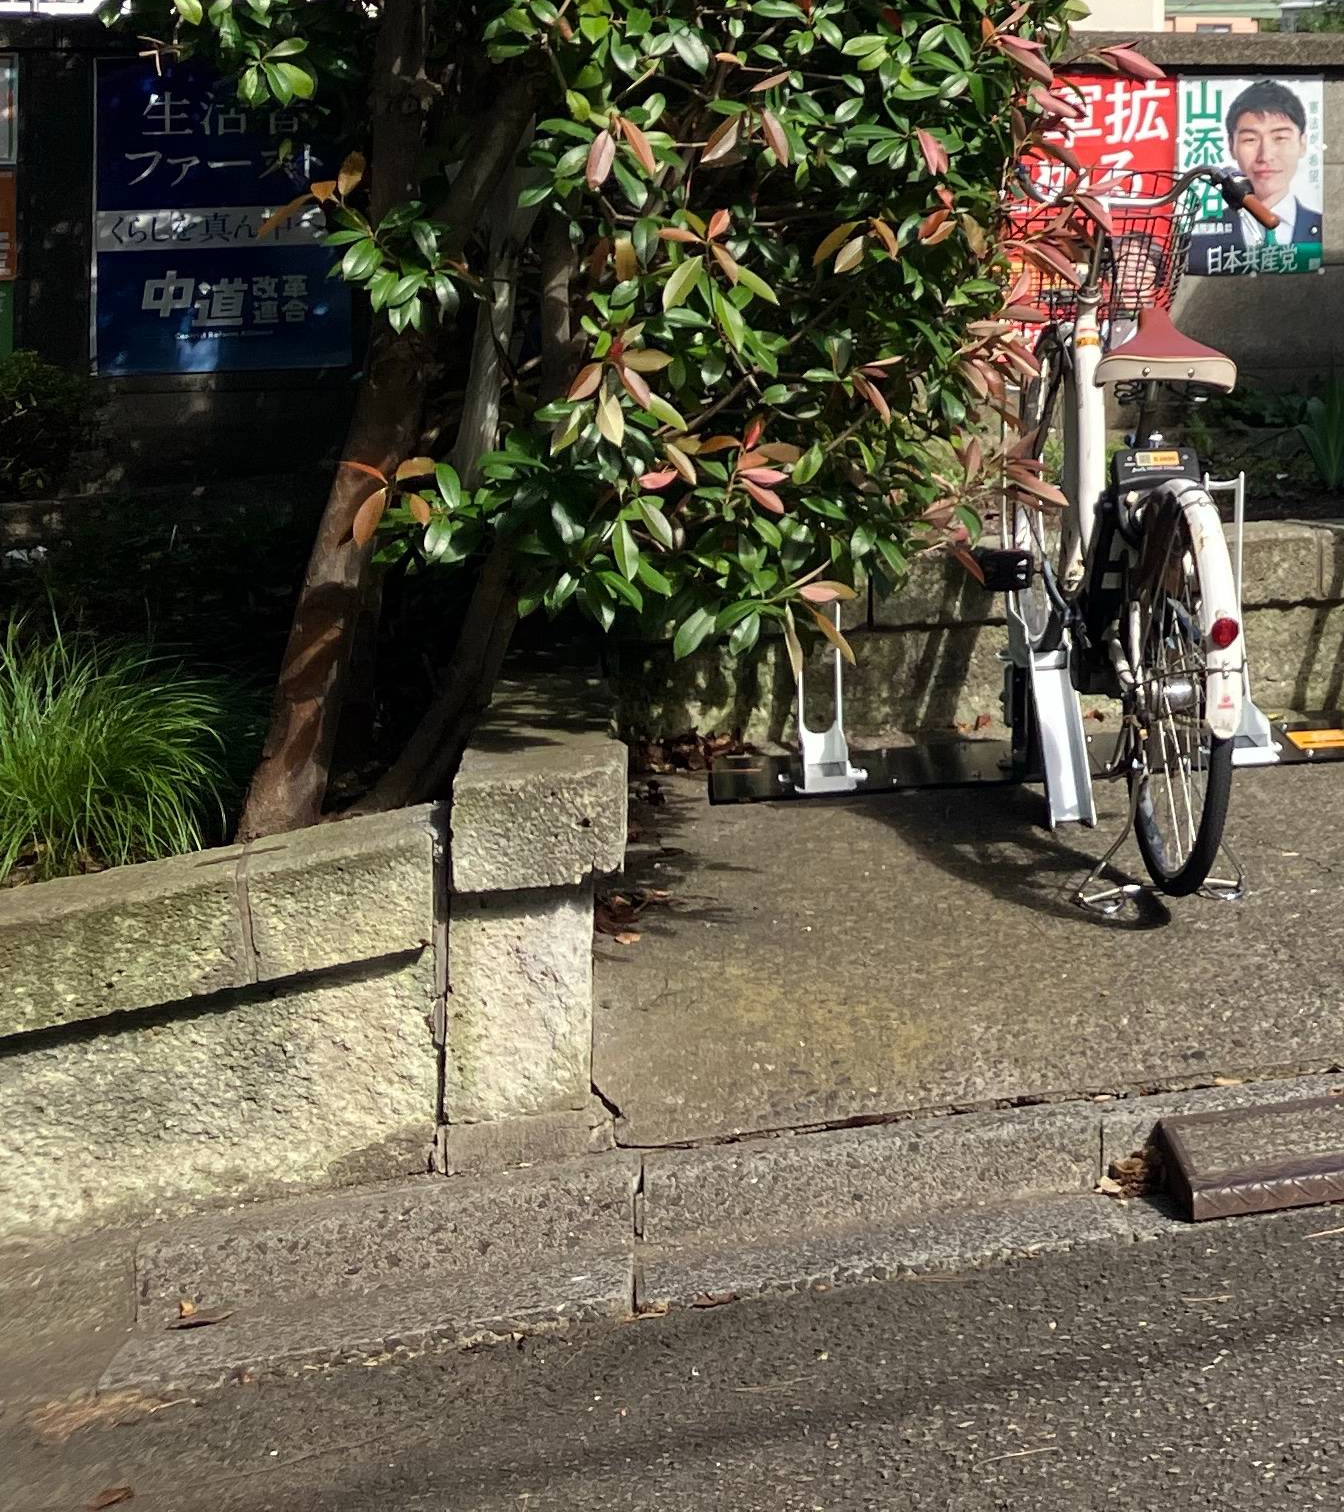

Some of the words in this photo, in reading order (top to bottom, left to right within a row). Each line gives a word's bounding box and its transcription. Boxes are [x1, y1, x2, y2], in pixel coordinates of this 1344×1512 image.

[1206, 243, 1298, 275] 日本共産党
[141, 269, 249, 328] 中道
